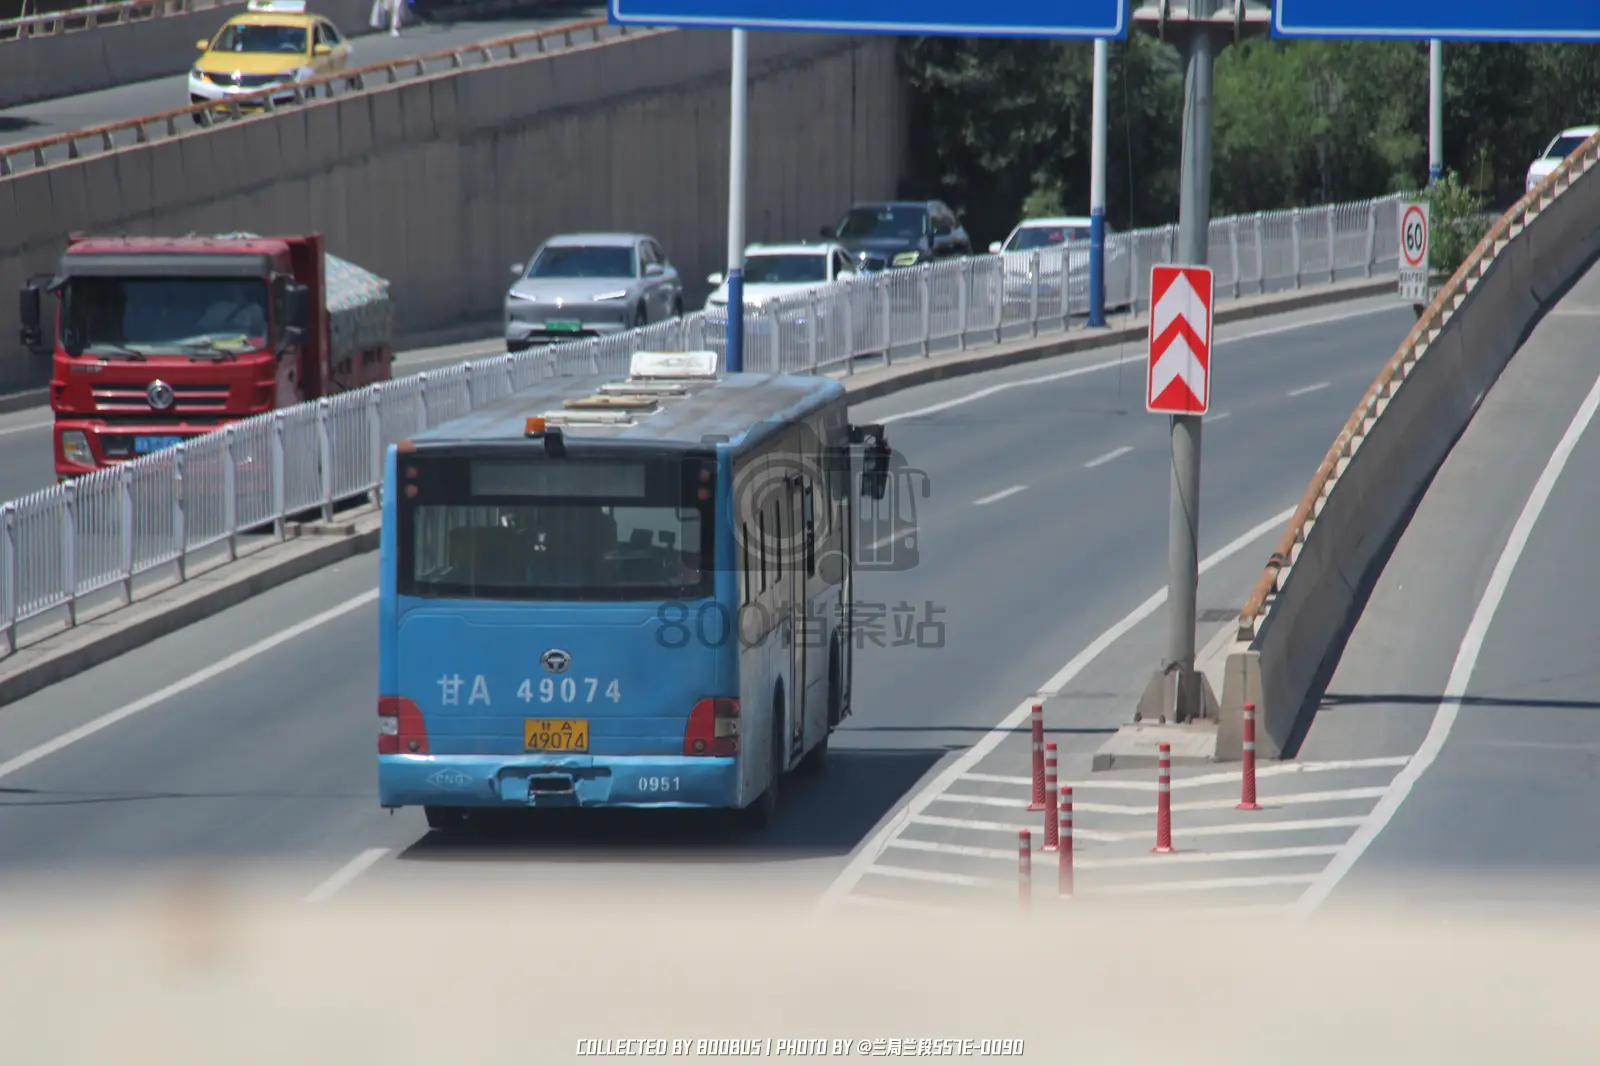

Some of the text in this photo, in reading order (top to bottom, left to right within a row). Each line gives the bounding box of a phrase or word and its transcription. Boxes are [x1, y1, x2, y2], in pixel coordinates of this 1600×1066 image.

[1406, 223, 1423, 251] 60
[437, 673, 621, 706] 甘A 49074
[528, 731, 585, 749] 49074
[638, 776, 681, 793] 0951
